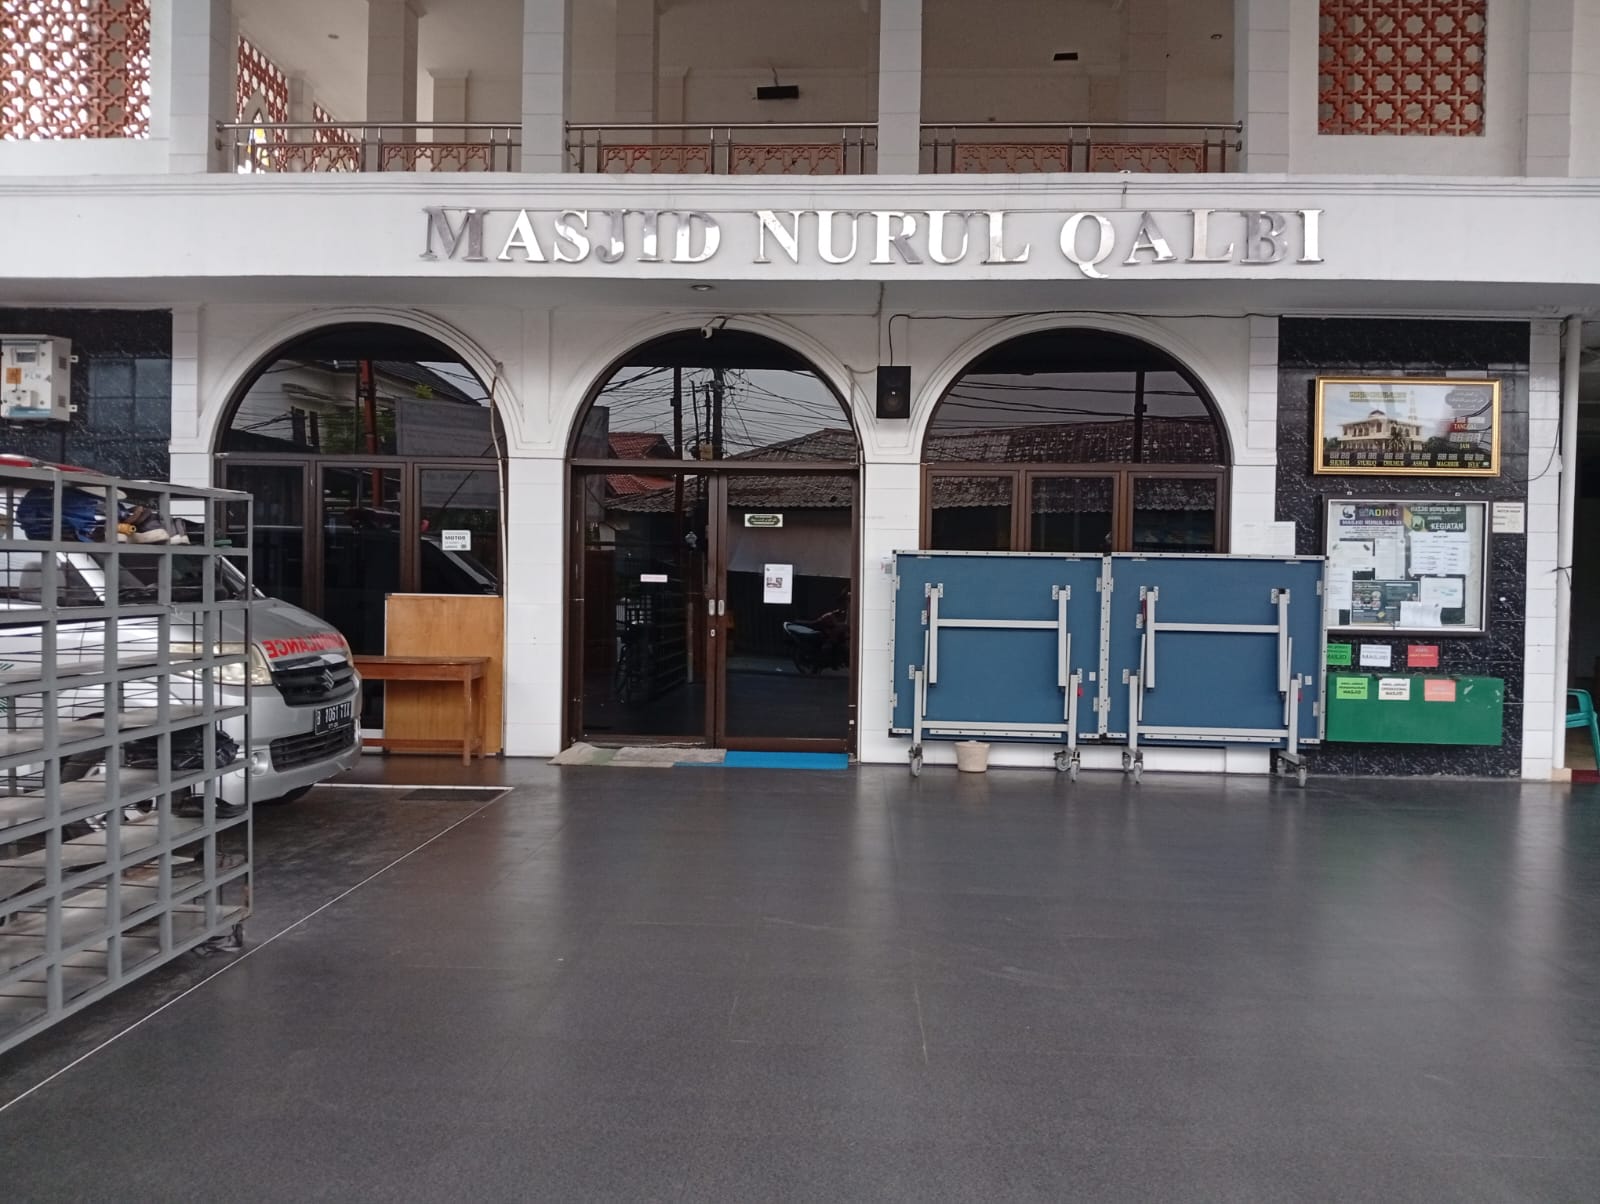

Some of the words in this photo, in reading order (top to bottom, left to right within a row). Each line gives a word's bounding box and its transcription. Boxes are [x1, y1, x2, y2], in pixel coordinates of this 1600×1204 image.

[419, 209, 720, 263] MASJID
[752, 209, 1031, 265] NURUL
[1060, 209, 1325, 279] QALBI
[1431, 522, 1464, 530] KEGIATAN
